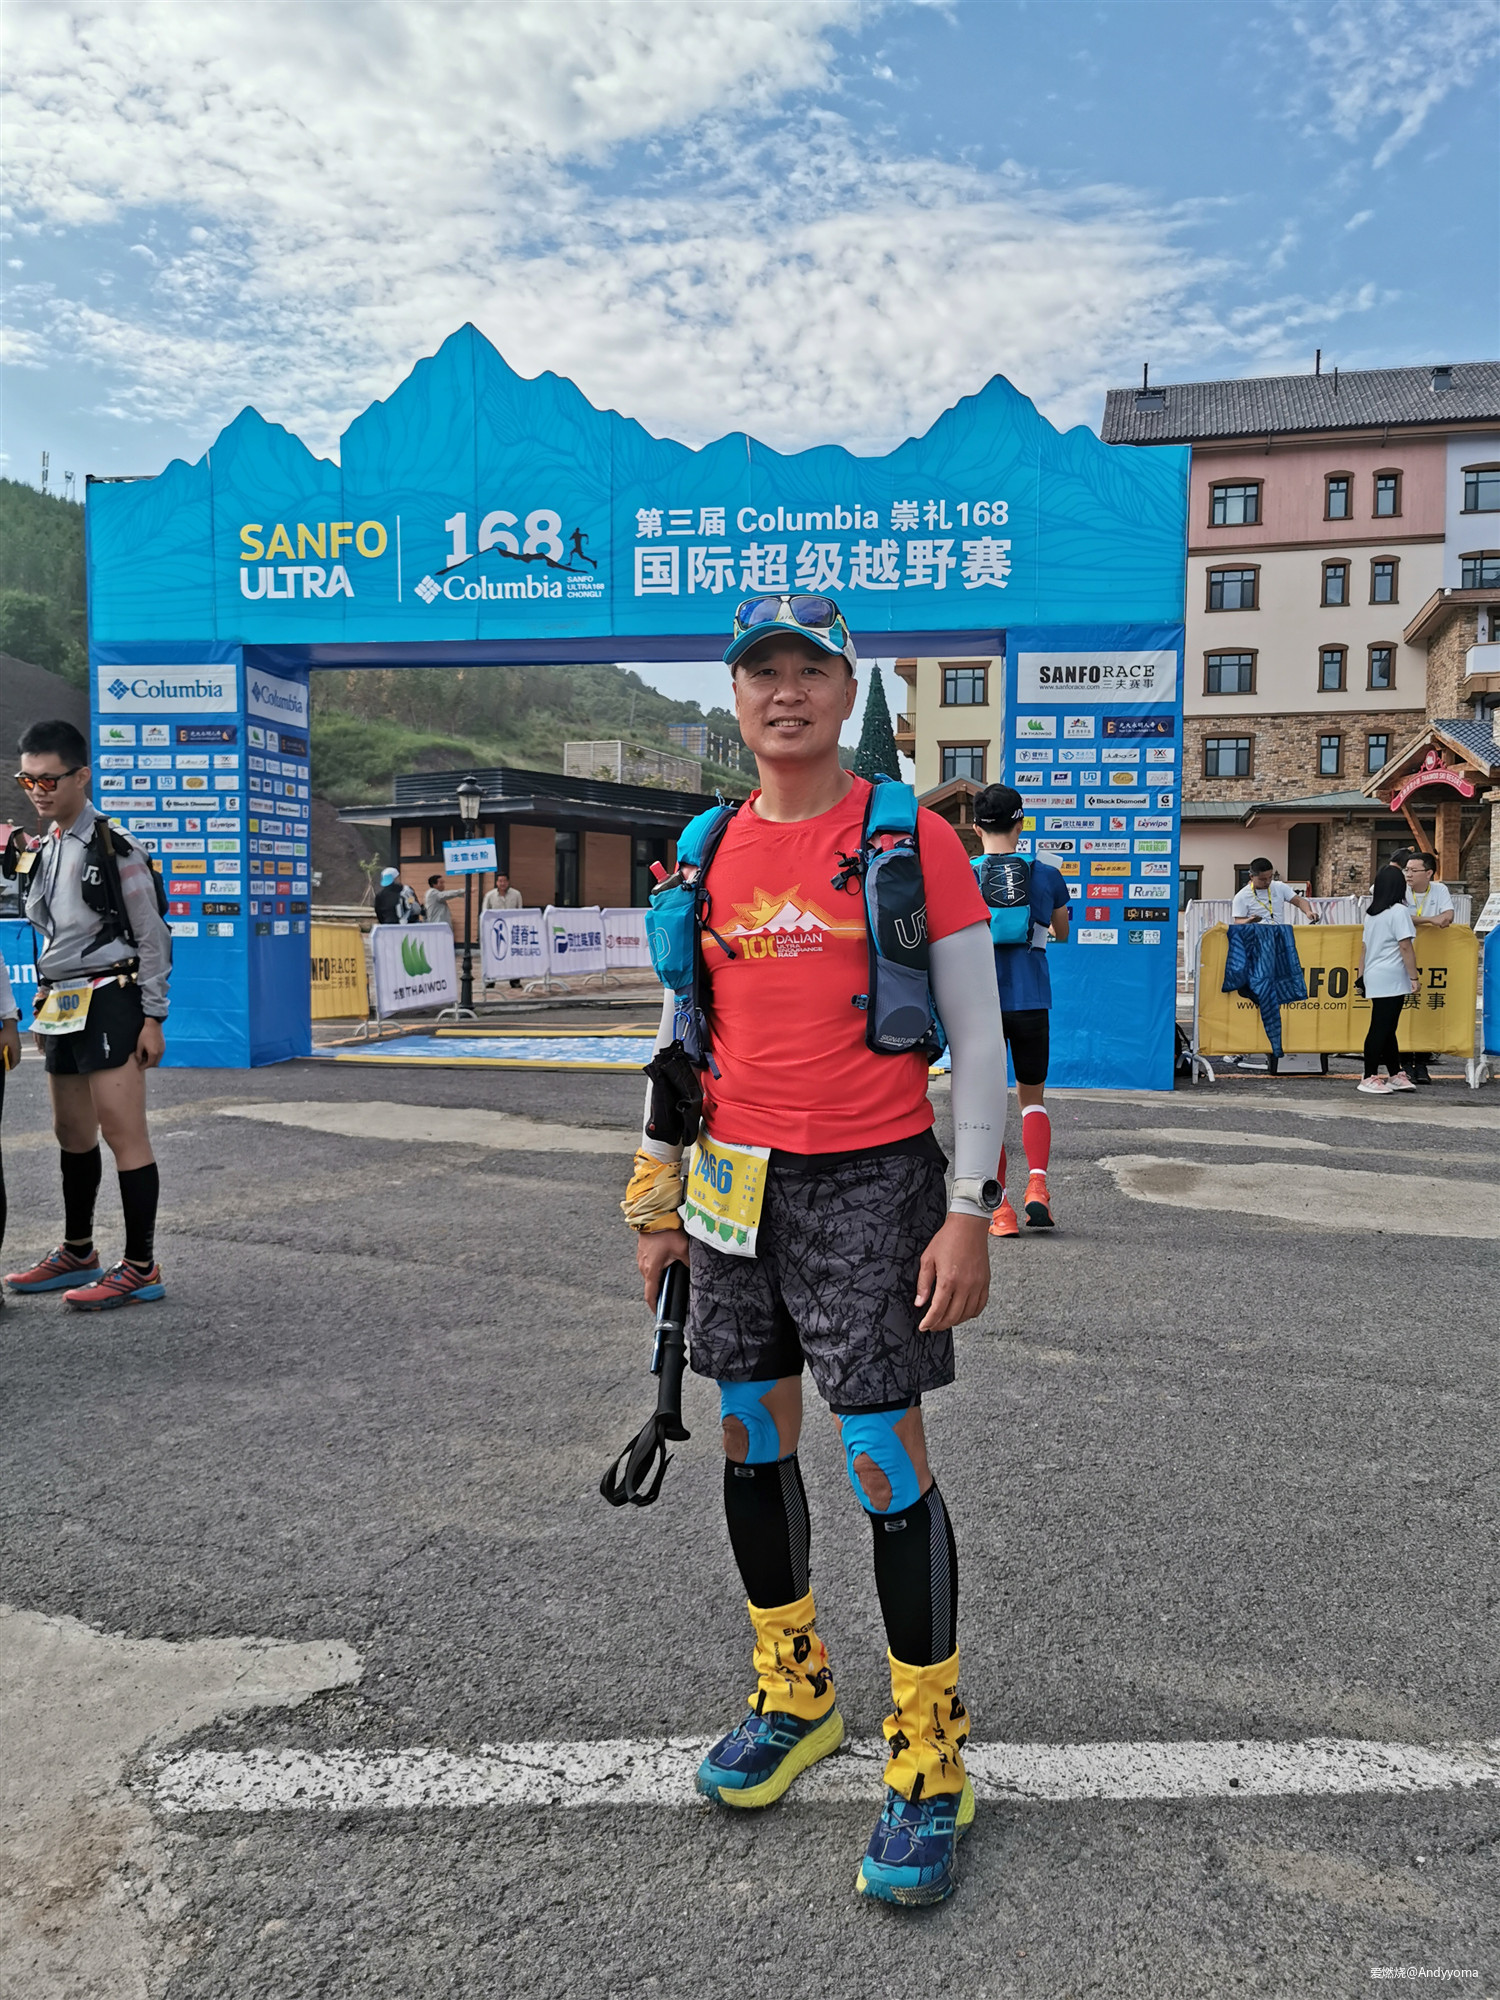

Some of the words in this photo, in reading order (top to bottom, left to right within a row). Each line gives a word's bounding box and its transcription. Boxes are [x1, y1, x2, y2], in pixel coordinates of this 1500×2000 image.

[634, 507, 726, 538] 第三届
[737, 504, 879, 534] Columbia
[891, 500, 1009, 532] 崇礼168
[240, 520, 388, 560] SANFO
[445, 509, 565, 567] 168
[634, 536, 1014, 597] 国际超级越野赛
[240, 565, 355, 600] ULTRA
[443, 574, 563, 600] Columbia
[567, 575, 594, 583] SANFO
[567, 590, 602, 598] CHONGLI
[1039, 665, 1101, 683] SANFO
[1102, 664, 1155, 678] RACE
[131, 679, 223, 698] Columbia
[1039, 683, 1100, 691] www.sanforace.com
[1102, 679, 1154, 690] 三夫赛事
[261, 685, 303, 713] Columbia
[1004, 864, 1015, 900] ULTIMATE
[1134, 886, 1166, 898] Runnar
[776, 932, 823, 944] DALIAN
[331, 957, 357, 974] RACE
[405, 979, 447, 998] THAIWOO
[1352, 992, 1446, 1010] 三赛事
[694, 1143, 734, 1194] 7466
